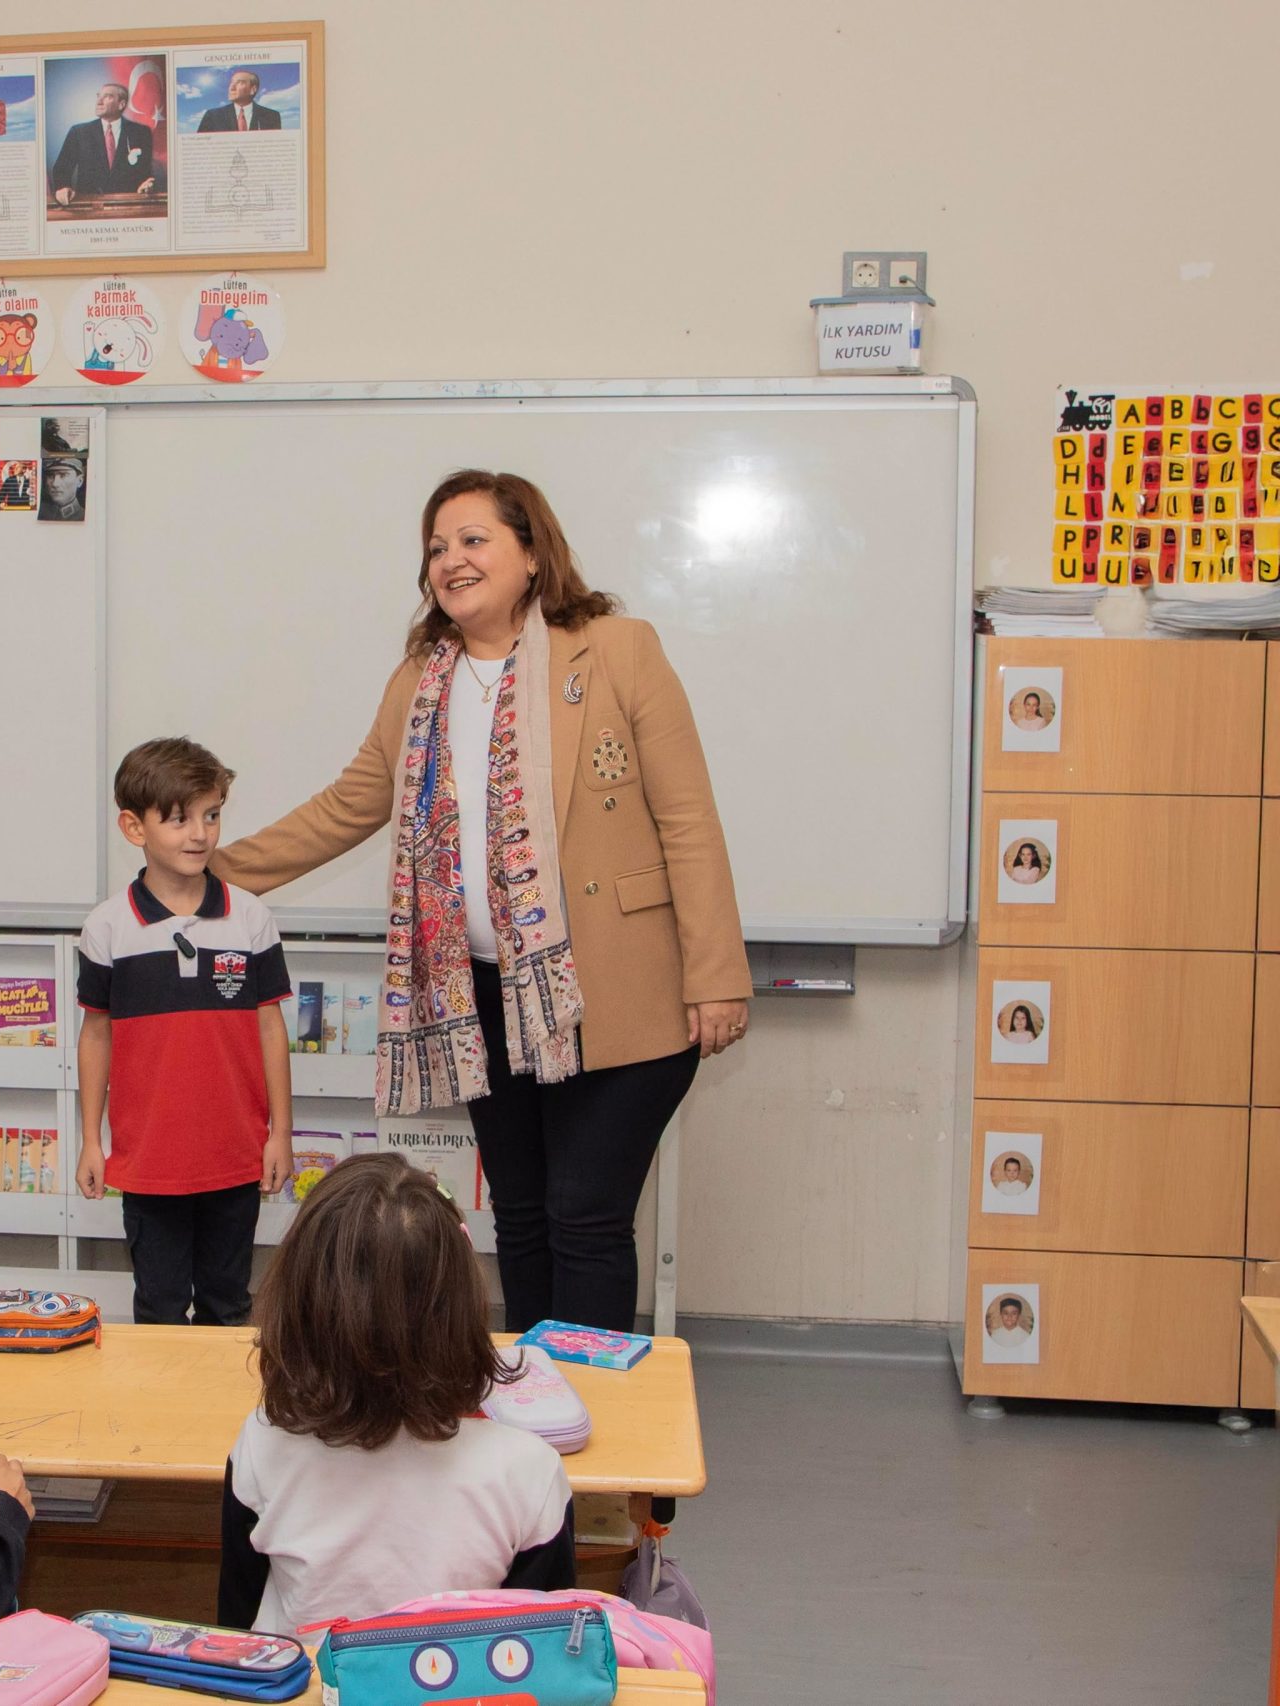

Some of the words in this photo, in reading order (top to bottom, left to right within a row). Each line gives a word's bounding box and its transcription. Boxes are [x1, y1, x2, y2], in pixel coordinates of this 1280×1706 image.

[103, 281, 126, 291] Lütfen
[222, 280, 247, 291] Lütfen
[5, 298, 38, 312] olalım
[94, 290, 136, 304] Parmak
[200, 290, 269, 307] Dinleyelim
[823, 324, 843, 339] İLK
[847, 323, 903, 337] YARDIM
[835, 346, 891, 359] KUTUSU
[1123, 404, 1140, 423] A
[1148, 403, 1161, 416] a
[1171, 399, 1183, 420] B
[1196, 399, 1209, 420] b
[1219, 399, 1237, 419] C
[1247, 401, 1260, 416] c
[1060, 438, 1076, 458] D
[1092, 438, 1104, 458] d
[1123, 436, 1135, 455] E
[1170, 433, 1183, 449] F
[1212, 432, 1232, 453] G
[1245, 429, 1260, 450] g
[1062, 465, 1080, 485] H
[1091, 465, 1104, 487] h
[1065, 496, 1078, 516] L
[1111, 525, 1123, 545] R
[1060, 559, 1076, 578] U
[1083, 561, 1095, 576] u
[388, 1131, 441, 1148] KURBAĞA
[443, 1134, 476, 1149] PREN
